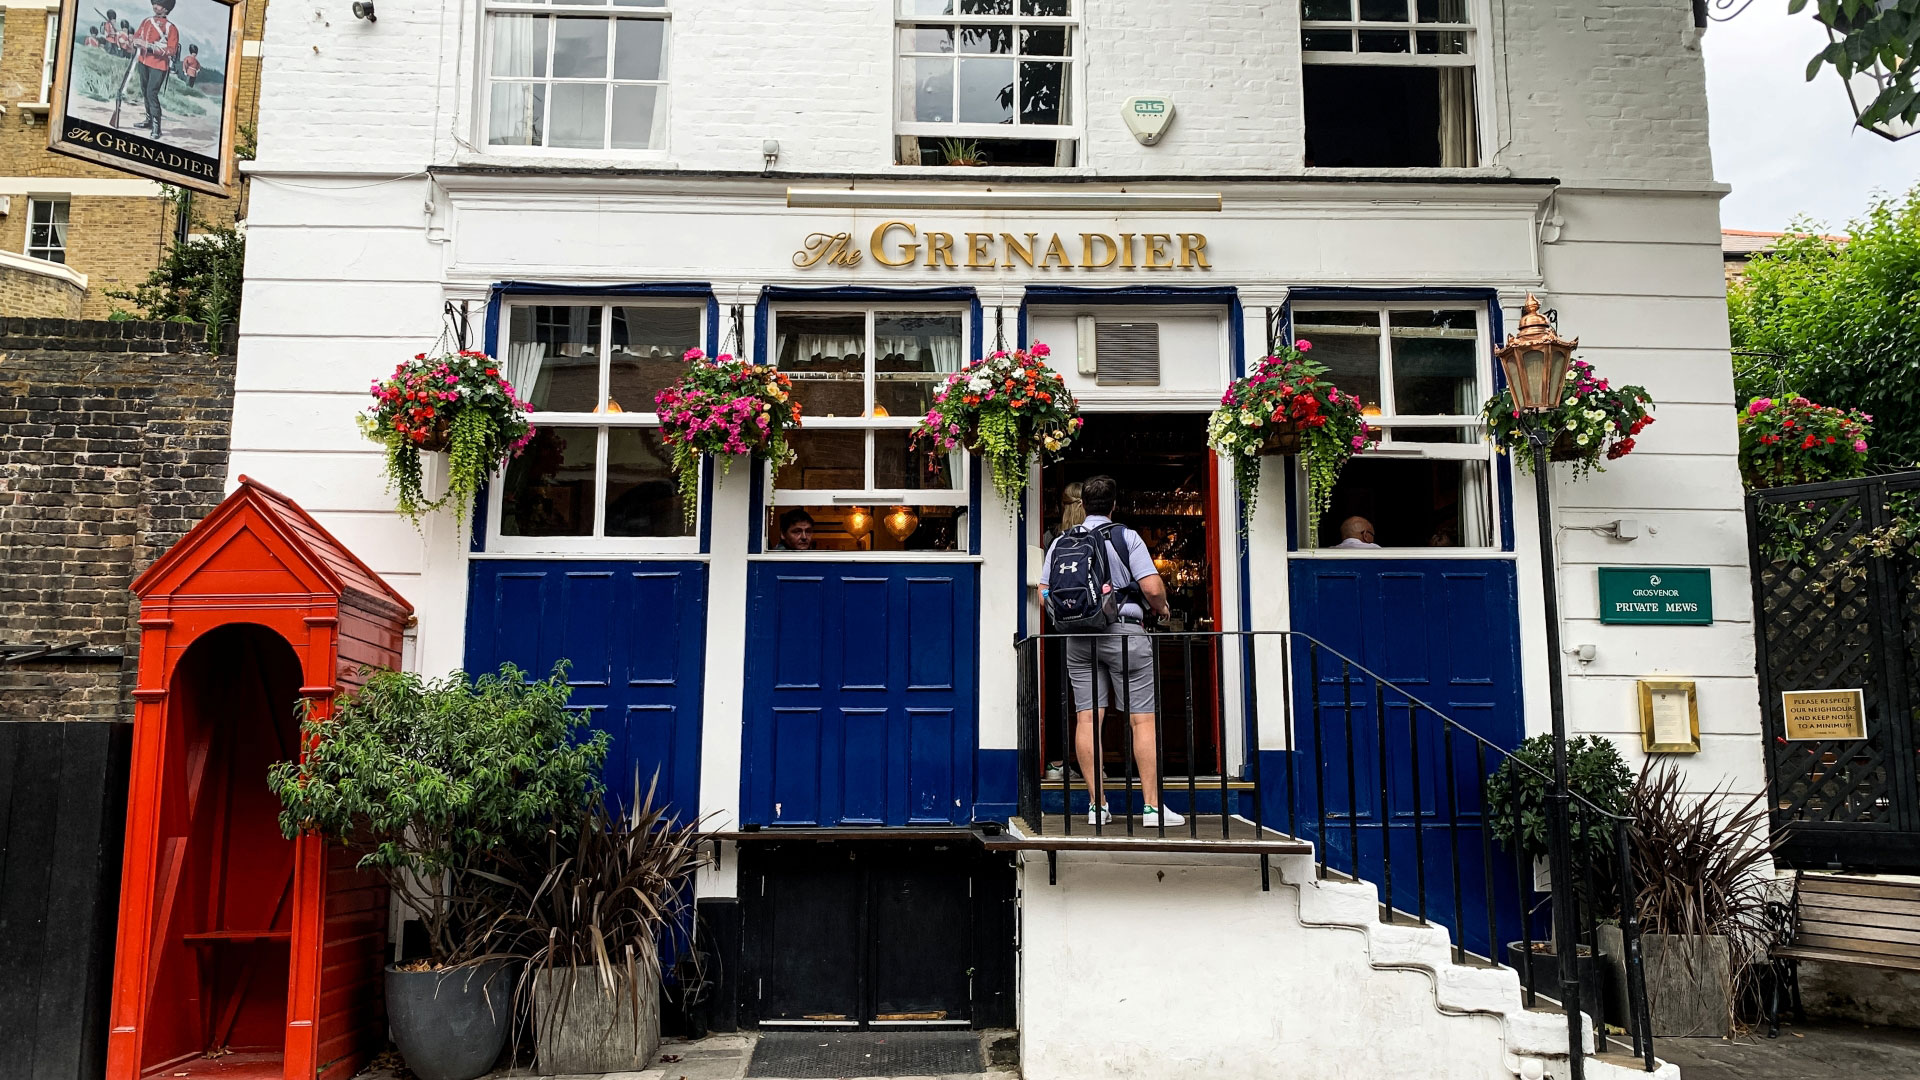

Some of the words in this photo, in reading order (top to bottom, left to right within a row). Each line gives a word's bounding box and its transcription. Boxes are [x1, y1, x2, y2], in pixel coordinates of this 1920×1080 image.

[67, 127, 94, 143] The
[96, 131, 214, 178] GRENADIER
[792, 232, 863, 267] The
[870, 221, 1213, 268] GRENADIER
[1616, 602, 1659, 612] PRIVATE
[1666, 603, 1698, 612] MEWS
[1632, 589, 1679, 597] GROSVENOR
